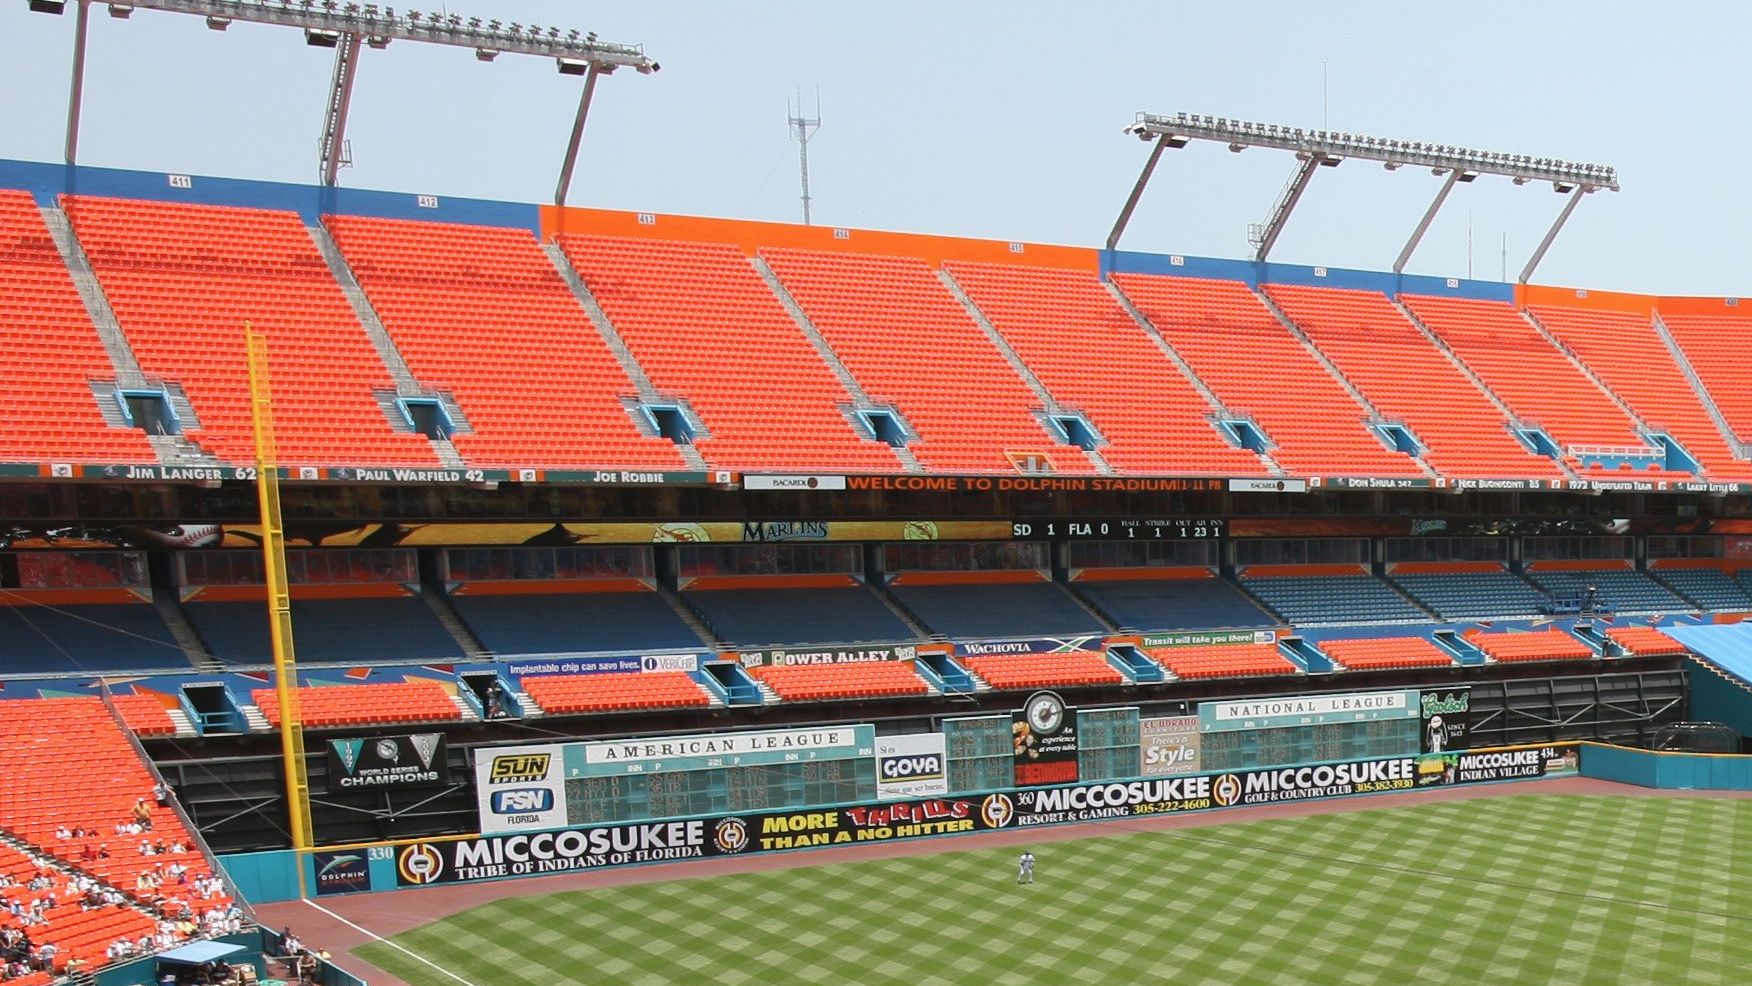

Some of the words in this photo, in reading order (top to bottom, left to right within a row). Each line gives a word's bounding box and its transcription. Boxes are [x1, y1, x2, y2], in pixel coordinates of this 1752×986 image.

[171, 177, 190, 187] 411
[420, 195, 436, 207] 412
[127, 466, 155, 479] JIM
[161, 467, 222, 480] LANGER
[235, 467, 256, 479] 62
[356, 469, 389, 481] PAUL
[394, 469, 459, 482] WARFIELD
[465, 470, 484, 481] 42
[593, 471, 618, 482] JOE
[622, 471, 664, 483] ROBBIE
[848, 477, 957, 490] WELCOME
[964, 479, 991, 490] TO
[998, 479, 1086, 491] DOLPHIN
[1091, 479, 1177, 491] STADIUM
[1349, 479, 1368, 488] DON
[1370, 479, 1395, 488] SHULA
[1569, 481, 1587, 489] 1972
[743, 521, 827, 543] MARLINS
[1144, 638, 1173, 646] Transit
[1176, 636, 1190, 644] will
[1192, 635, 1209, 643] take
[1229, 634, 1252, 642] there!
[963, 643, 1031, 655] WACHOVIA
[772, 651, 832, 666] POWER
[838, 650, 889, 663] ALLEY
[510, 663, 559, 675] Implantable
[561, 663, 580, 673] chip
[620, 661, 639, 670] lives.
[1230, 701, 1315, 716] NATIONAL
[1332, 696, 1395, 709] LEAGUE
[1159, 719, 1196, 727] DORADO
[606, 739, 734, 759] AMERICAN
[752, 733, 839, 749] LEAGUE
[1042, 736, 1076, 744] experience
[1146, 746, 1195, 766] Style
[1460, 751, 1539, 770] MICCOSUKEE
[391, 766, 420, 774] SERIES
[497, 757, 545, 774] SUN
[884, 757, 940, 777] GOYA
[1460, 766, 1496, 780] INDIAN
[1500, 765, 1539, 777] VILLAGE
[340, 771, 438, 787] CHAMPIONS
[492, 775, 543, 784] SPORTS
[1245, 759, 1413, 793] MICCOSUKEE
[1018, 792, 1034, 806] 360
[1035, 777, 1210, 813] MICCOSUKEE
[1245, 792, 1270, 803] GOLF
[1271, 791, 1278, 801] &
[1280, 787, 1325, 800] COUNTRY
[1327, 784, 1351, 795] CLUB
[1355, 779, 1413, 793] 305-382-3930
[500, 790, 545, 811] FSN
[507, 815, 540, 824] FLORIDA
[762, 812, 838, 833] MORE
[845, 800, 969, 827] THRILLS
[1018, 811, 1065, 826] RESORT
[1068, 812, 1077, 821] &
[1080, 807, 1129, 820] GAMING
[1133, 799, 1210, 815] 305-222-4600
[760, 832, 830, 849] THAN
[835, 830, 852, 842] A
[857, 826, 893, 840] NO
[897, 819, 974, 837] HITTER
[455, 821, 704, 868] MICCOSUKEE
[369, 847, 394, 860] 330
[456, 864, 508, 881] TRIBE
[513, 862, 534, 874] OF
[538, 855, 606, 872] INDIANS
[610, 853, 632, 864] OF
[636, 846, 702, 862] FLORIDA
[322, 870, 365, 880] DOLPHIN
